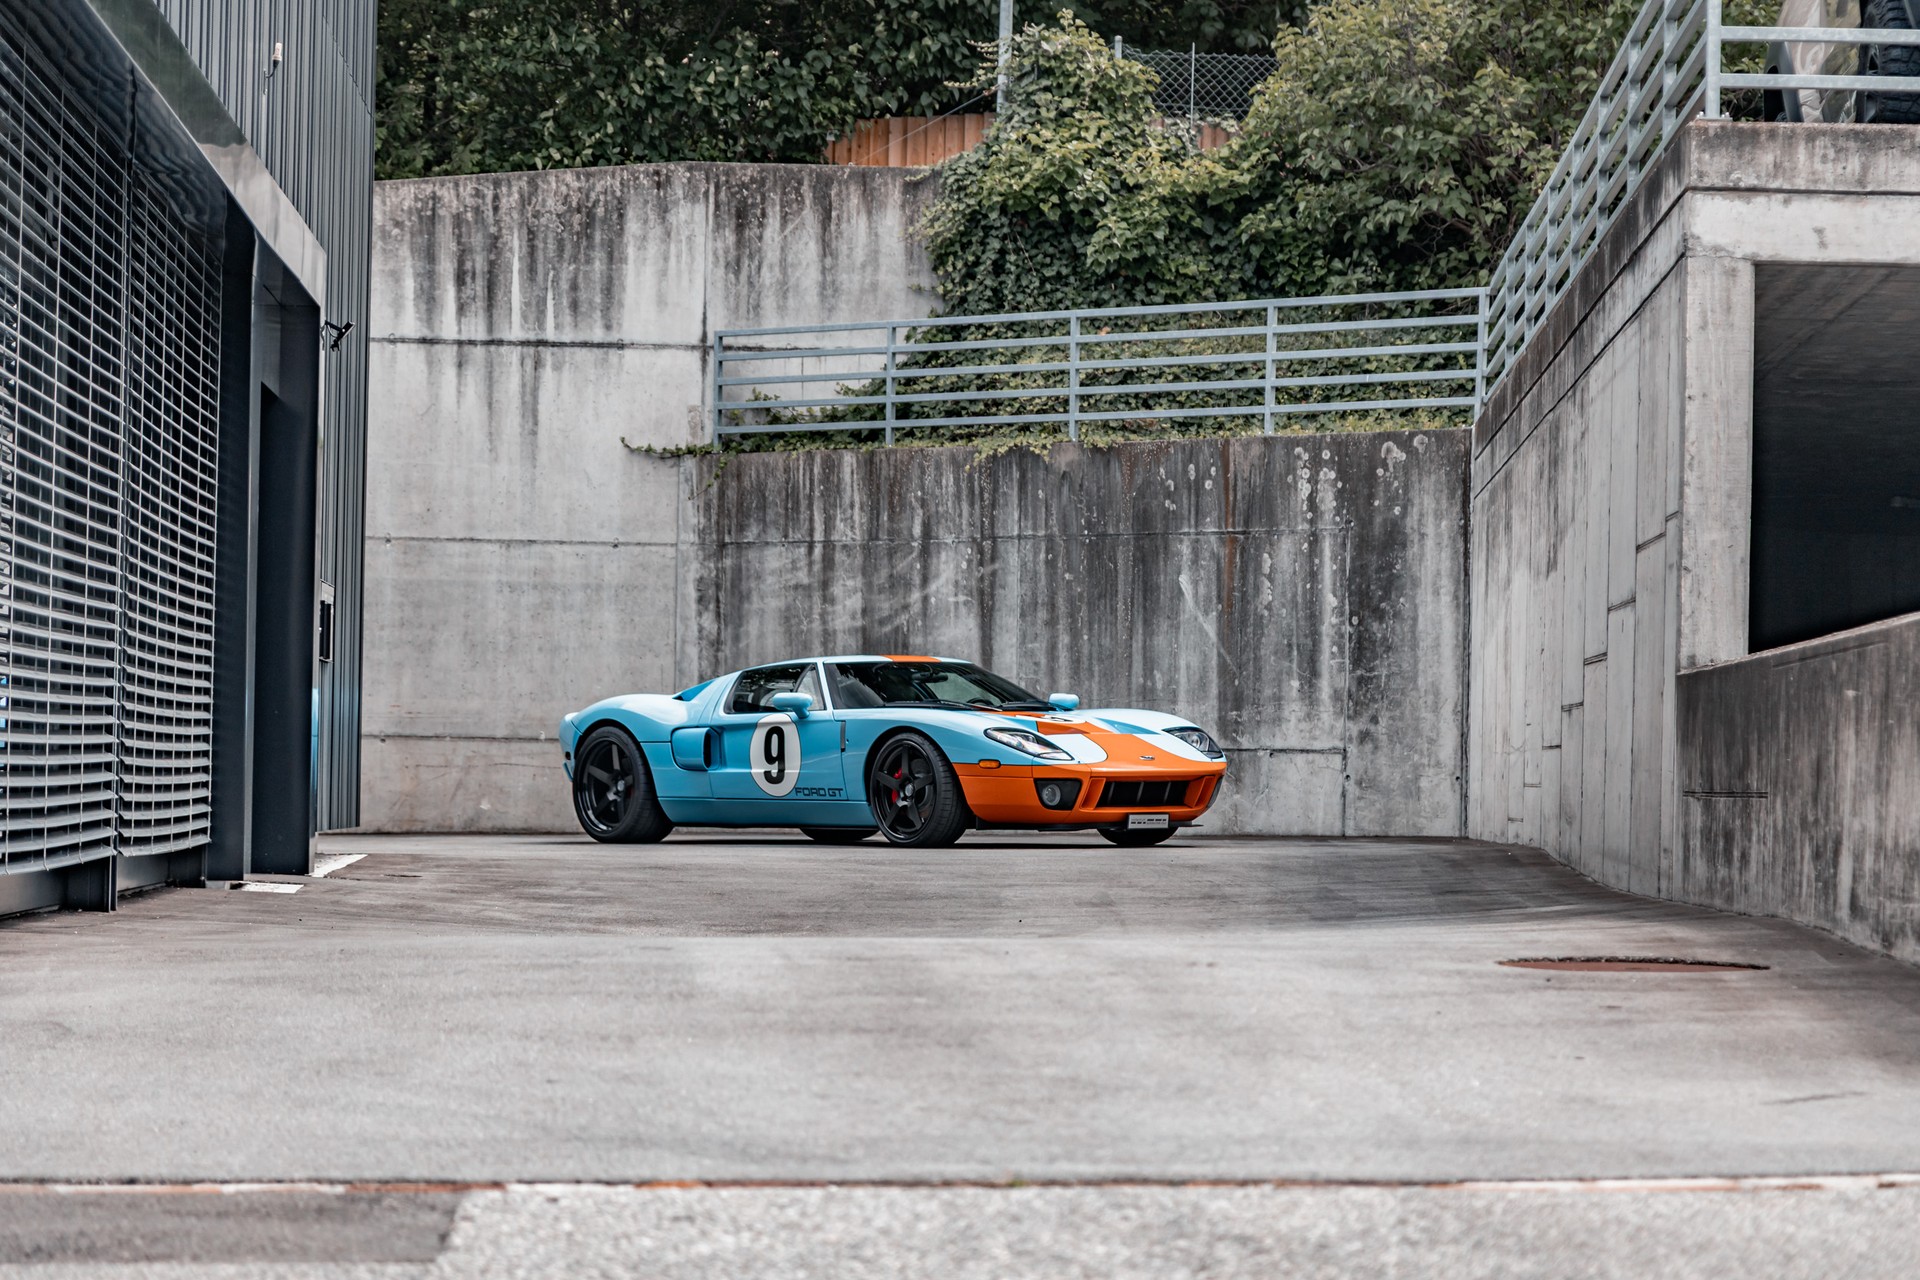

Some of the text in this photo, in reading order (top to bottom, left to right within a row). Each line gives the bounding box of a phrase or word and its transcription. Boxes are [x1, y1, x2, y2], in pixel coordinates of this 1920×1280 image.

[764, 725, 785, 785] 9
[795, 787, 843, 797] FORD GT
